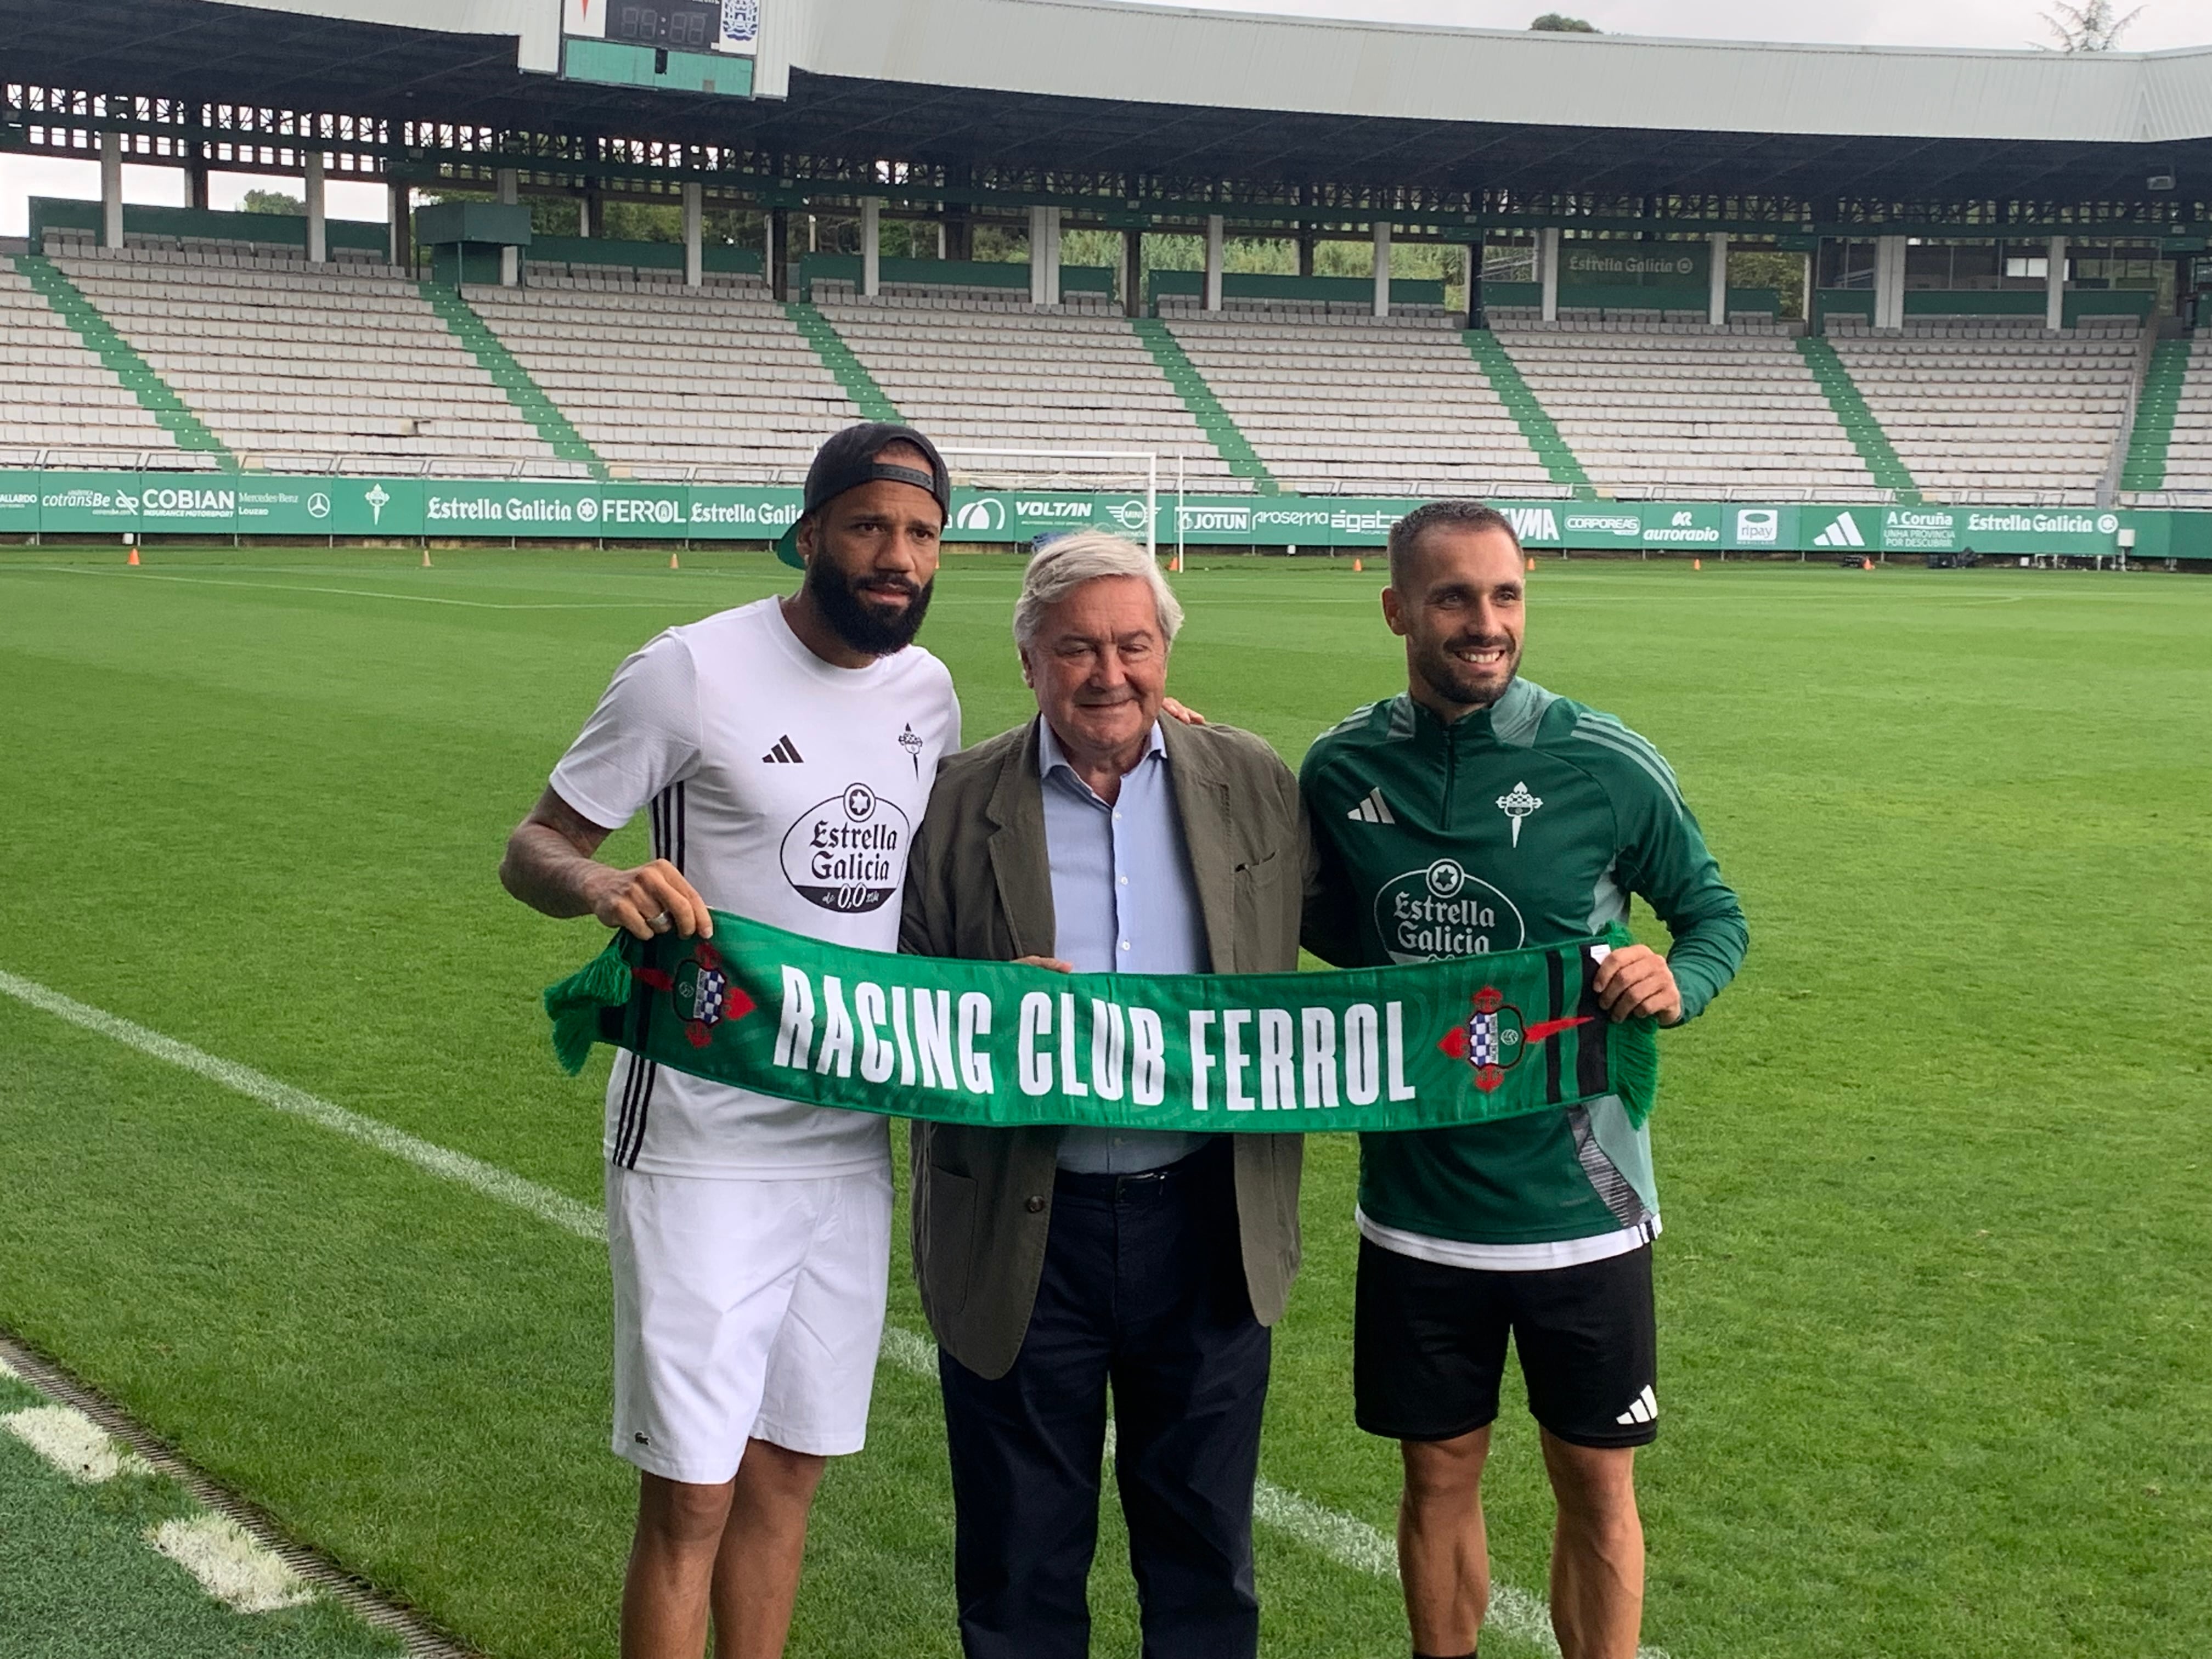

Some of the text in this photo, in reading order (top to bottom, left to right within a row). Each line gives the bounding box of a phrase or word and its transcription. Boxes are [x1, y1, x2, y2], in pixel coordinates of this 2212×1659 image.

[1569, 256, 1673, 273] Estrella Galicia
[42, 493, 110, 507] cotransBe
[143, 489, 235, 509] COBIAN
[238, 493, 298, 503] Mercedes-Benz
[427, 496, 572, 521] Estrella Galicia
[602, 500, 686, 523] FERROL
[690, 501, 756, 523] Estrella
[1015, 501, 1092, 517] VOLTAN
[1194, 513, 1247, 529] JOTUN
[1566, 517, 1638, 529] CORPOREAS
[1887, 511, 1954, 526] A Coruña
[1967, 514, 2093, 533] Estrella Galicia
[1741, 526, 1773, 538] ripay
[1883, 530, 1909, 538] UNHA
[1885, 538, 1904, 546] POR
[809, 820, 898, 851] Estrella
[811, 851, 890, 881] Galicia
[1393, 891, 1496, 928] Estrella
[1397, 921, 1490, 955] Galicia
[772, 964, 995, 1095] RACING
[1018, 991, 1165, 1105] CLUB
[1189, 1001, 1416, 1111] FERROL
